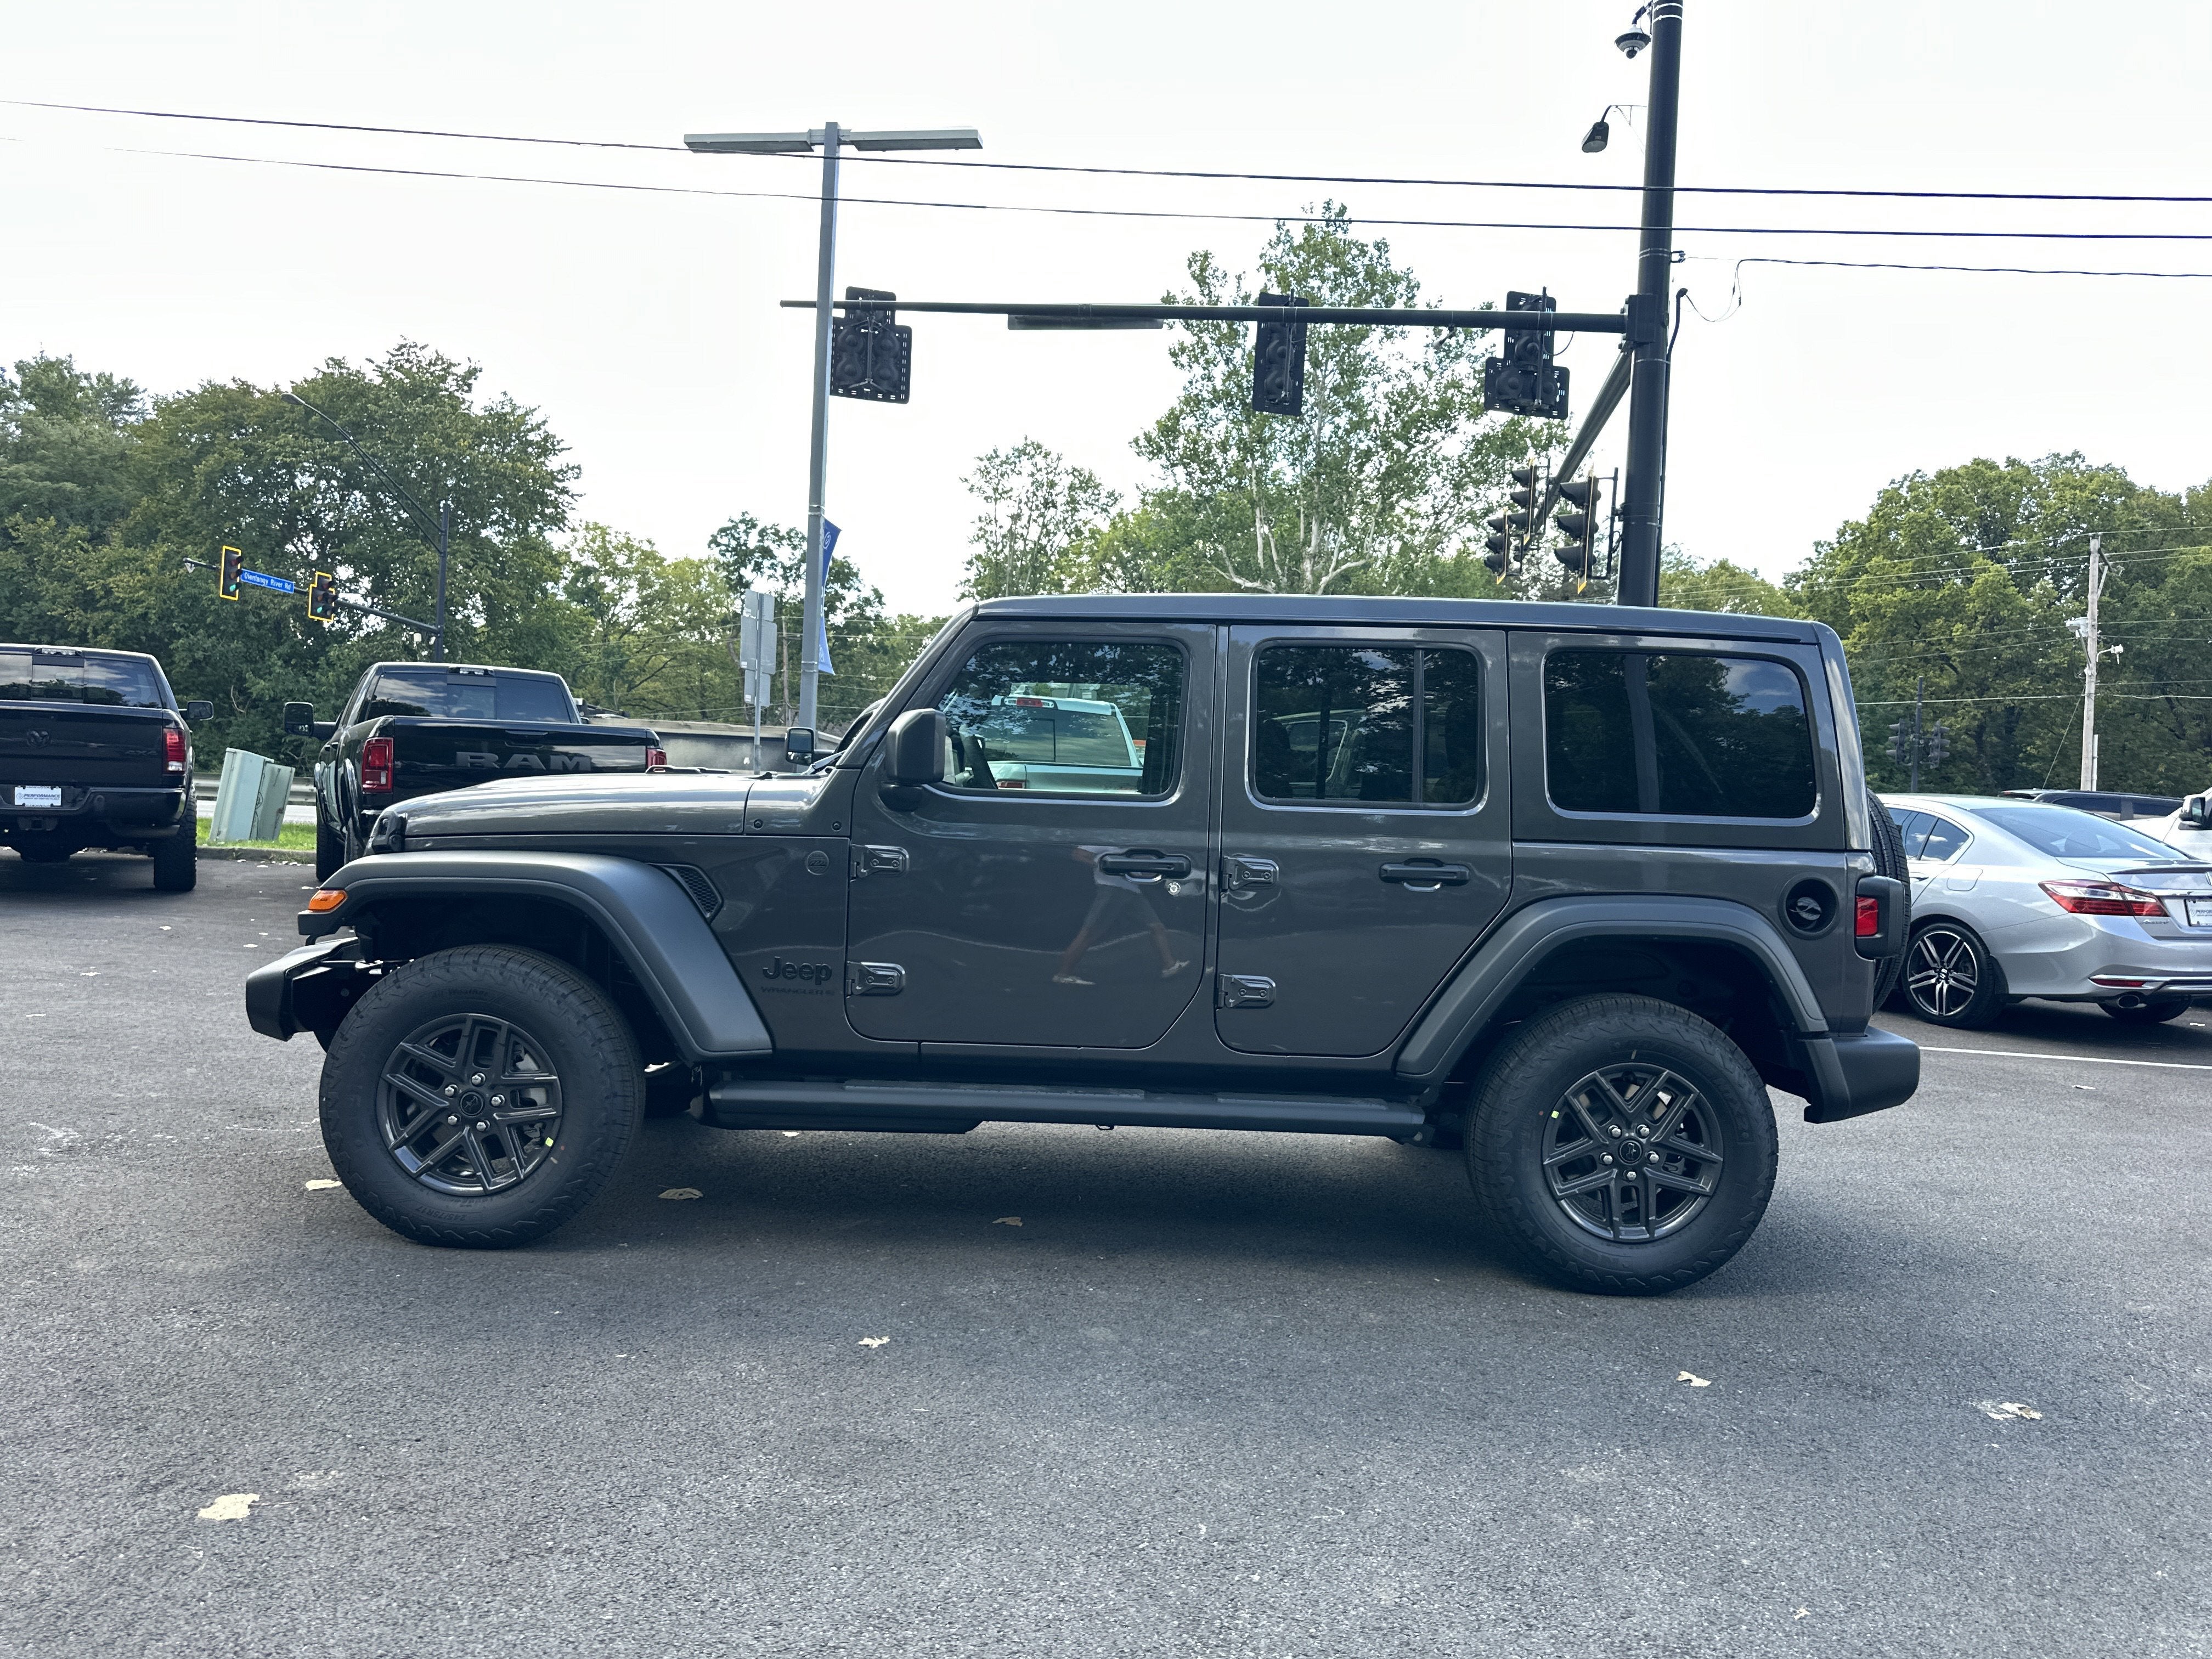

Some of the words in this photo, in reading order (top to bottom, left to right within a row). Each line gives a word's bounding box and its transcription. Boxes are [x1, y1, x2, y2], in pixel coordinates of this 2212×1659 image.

[244, 572, 269, 586] Olentangy
[270, 579, 283, 588] River
[456, 751, 592, 771] RAM
[763, 956, 832, 985] Jeep
